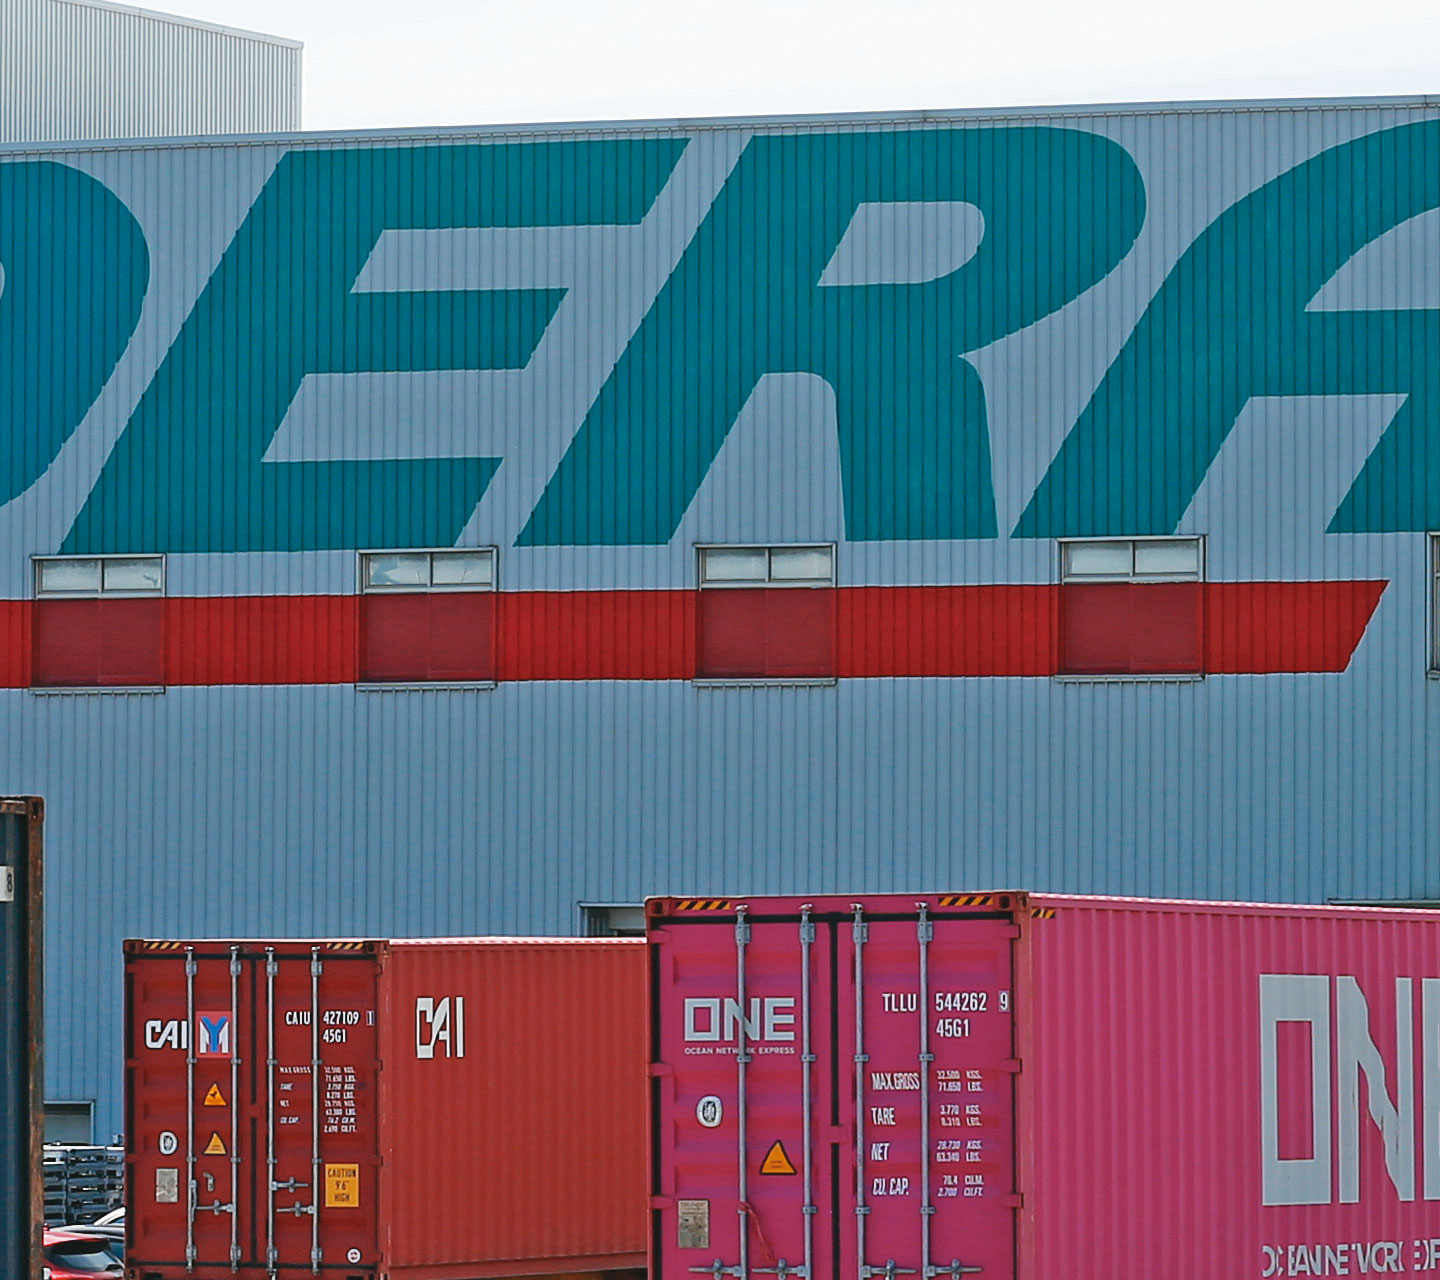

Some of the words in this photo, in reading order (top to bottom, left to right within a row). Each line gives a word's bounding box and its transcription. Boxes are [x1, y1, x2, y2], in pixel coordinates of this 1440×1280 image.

[882, 993, 917, 1013] TLLU
[935, 992, 987, 1013] 544262
[1000, 991, 1009, 1012] 9
[285, 1011, 311, 1026] CAIU
[323, 1011, 359, 1026] 427109
[416, 996, 465, 1059] CAI
[684, 998, 795, 1041] ONE
[145, 1020, 188, 1049] CAI
[323, 1029, 346, 1043] 45G1
[936, 1019, 970, 1038] 45G1
[716, 1047, 755, 1055] NETWRK
[871, 1107, 896, 1125] TARE
[871, 1143, 890, 1160] NET
